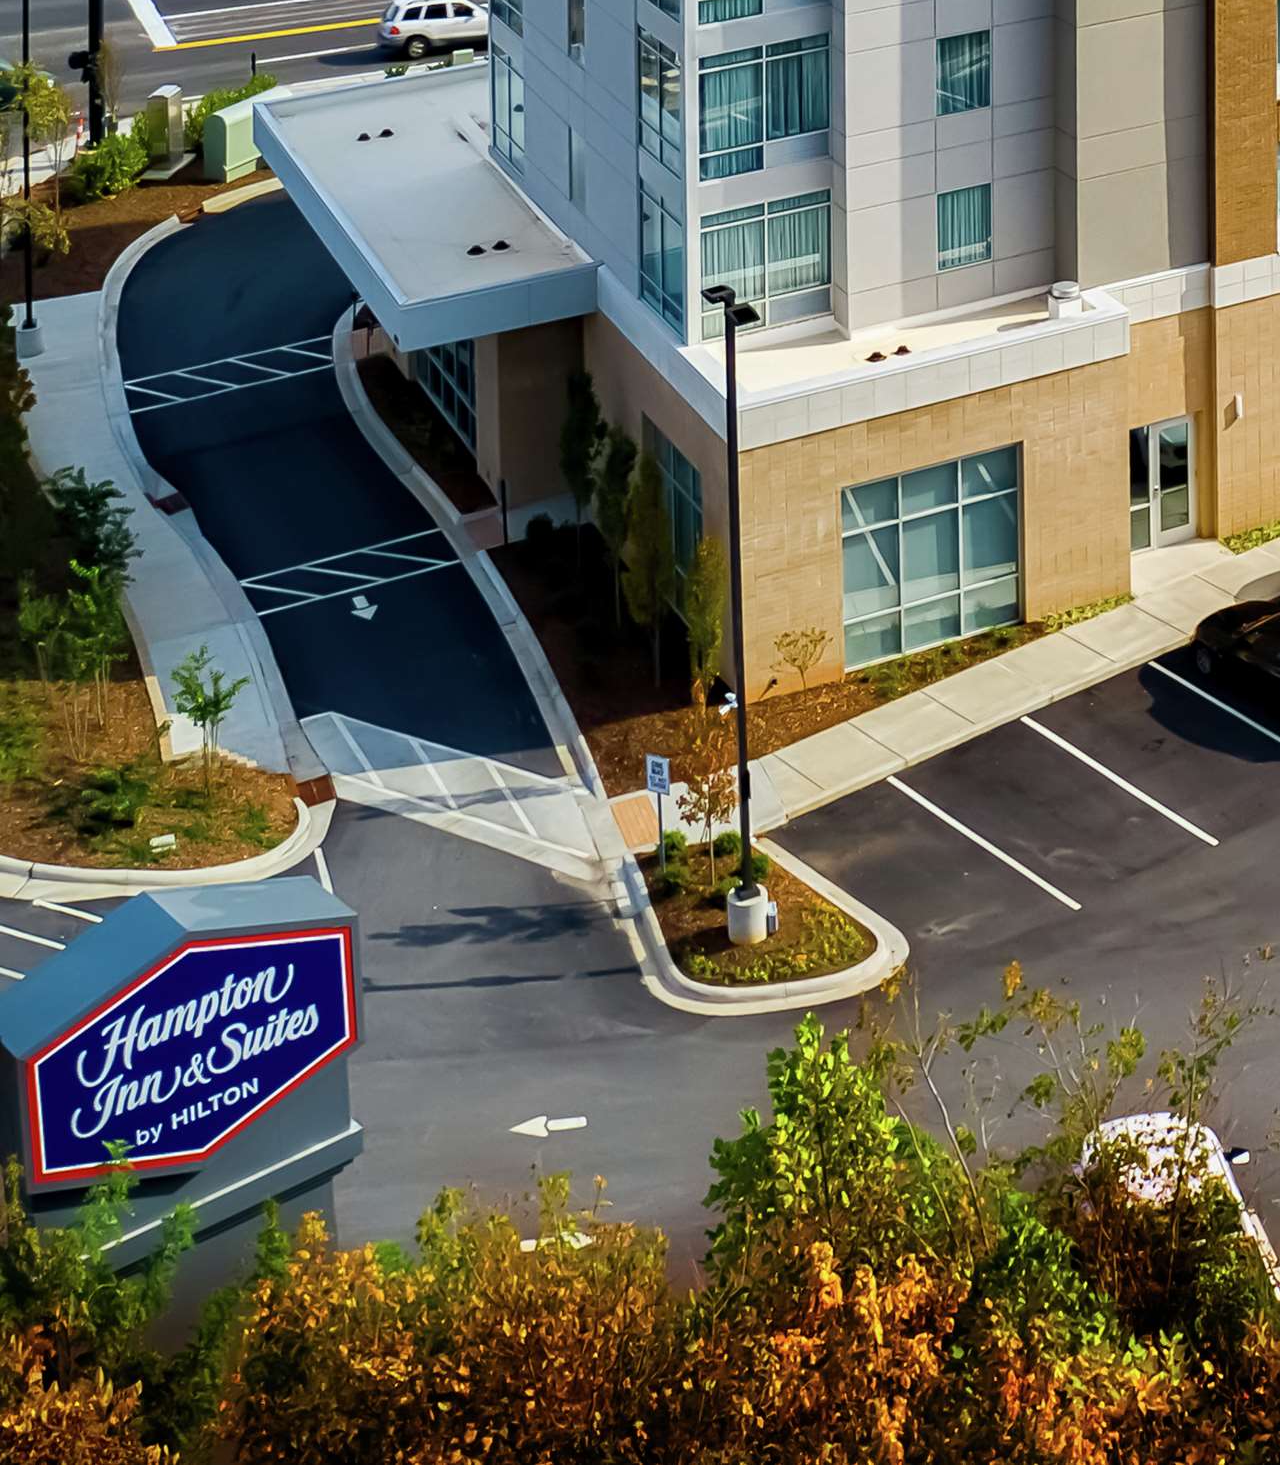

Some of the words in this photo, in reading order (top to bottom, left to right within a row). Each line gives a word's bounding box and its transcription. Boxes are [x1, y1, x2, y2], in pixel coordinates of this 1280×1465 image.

[70, 1064, 182, 1139] Inn
[182, 1054, 211, 1088] &
[206, 1004, 320, 1075] Suites
[76, 963, 294, 1088] Hampton
[136, 1122, 164, 1147] by
[171, 1077, 260, 1131] HILTON
